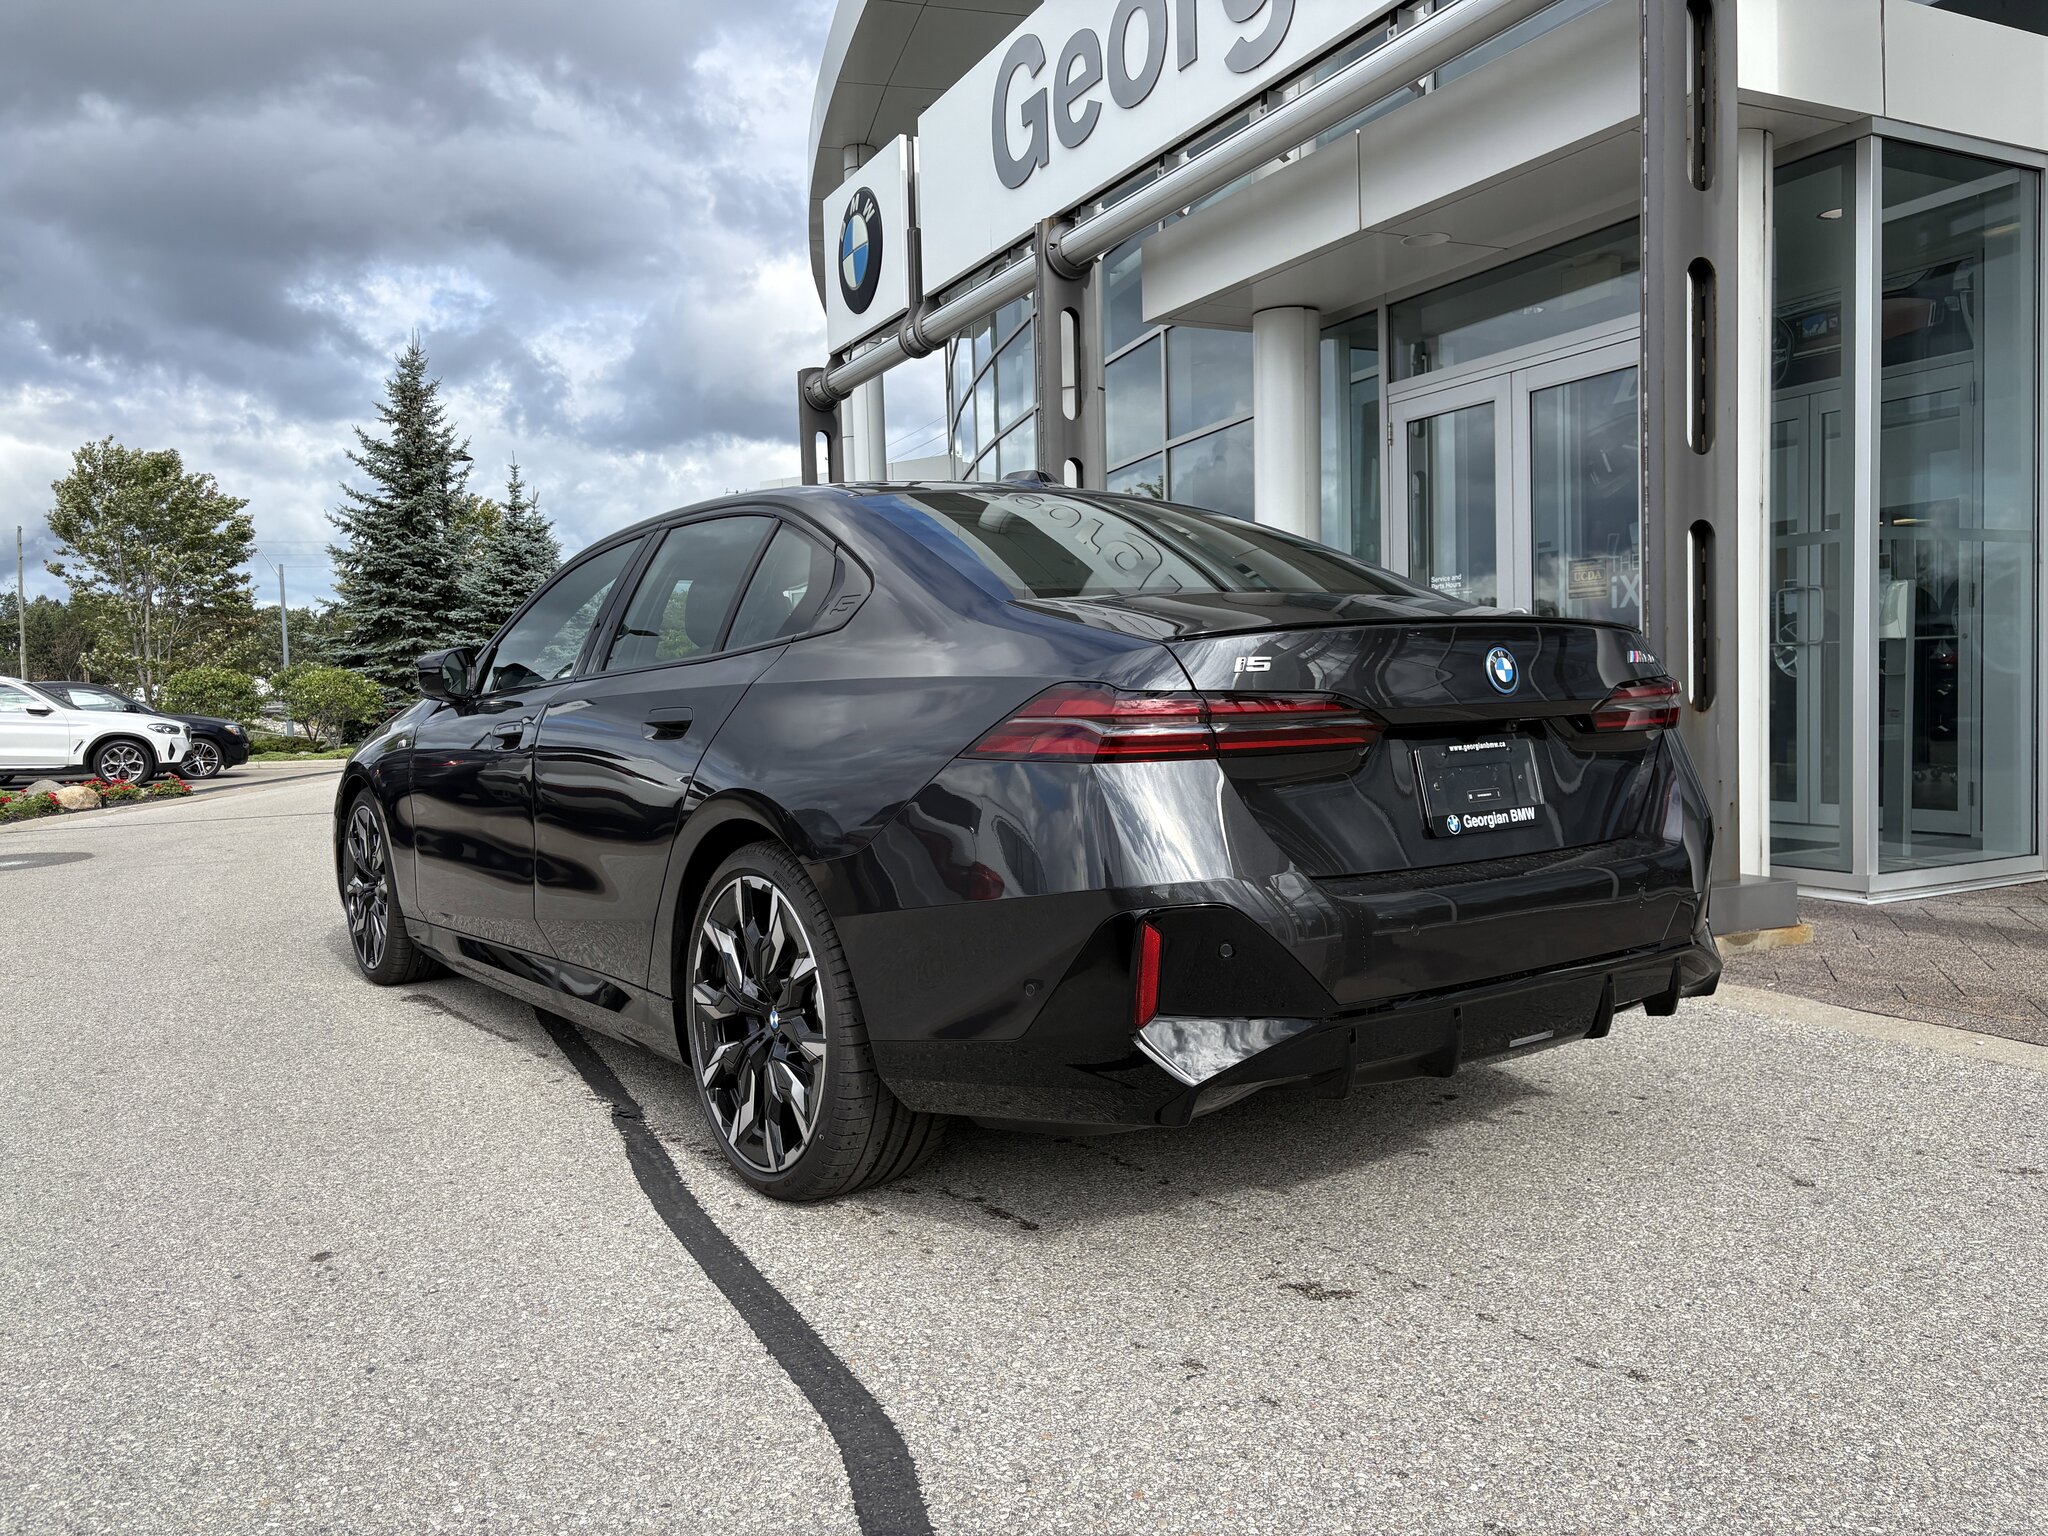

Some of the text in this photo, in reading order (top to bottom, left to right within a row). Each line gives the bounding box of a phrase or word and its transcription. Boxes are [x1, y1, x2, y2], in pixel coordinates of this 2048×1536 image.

[1451, 573, 1462, 581] and
[1573, 570, 1603, 582] UCDA
[1233, 656, 1272, 673] i5
[1448, 741, 1506, 752] www.georgianbmw.ca
[1462, 806, 1535, 829] Georgian BMW
